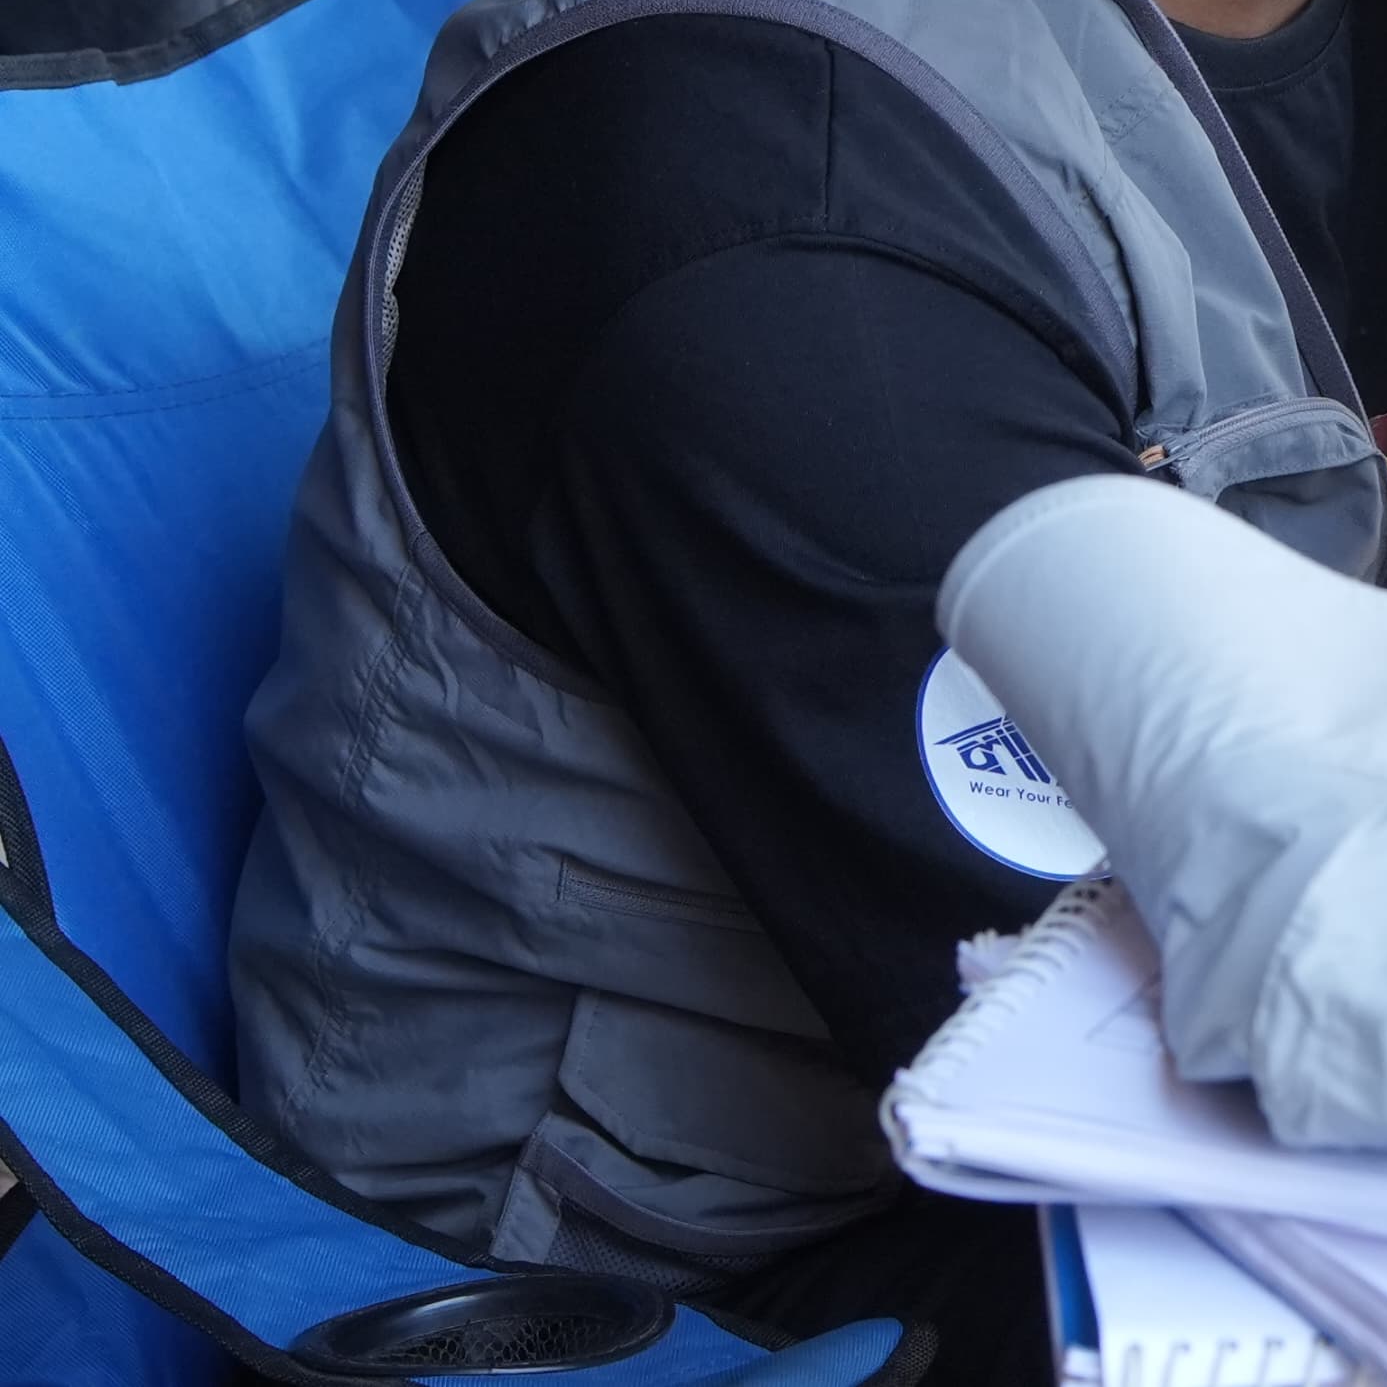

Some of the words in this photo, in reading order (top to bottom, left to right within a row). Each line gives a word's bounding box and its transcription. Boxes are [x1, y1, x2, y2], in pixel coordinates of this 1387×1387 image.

[969, 780, 1010, 799] Wear
[1016, 787, 1051, 806] Your
[1056, 795, 1074, 810] Fe
